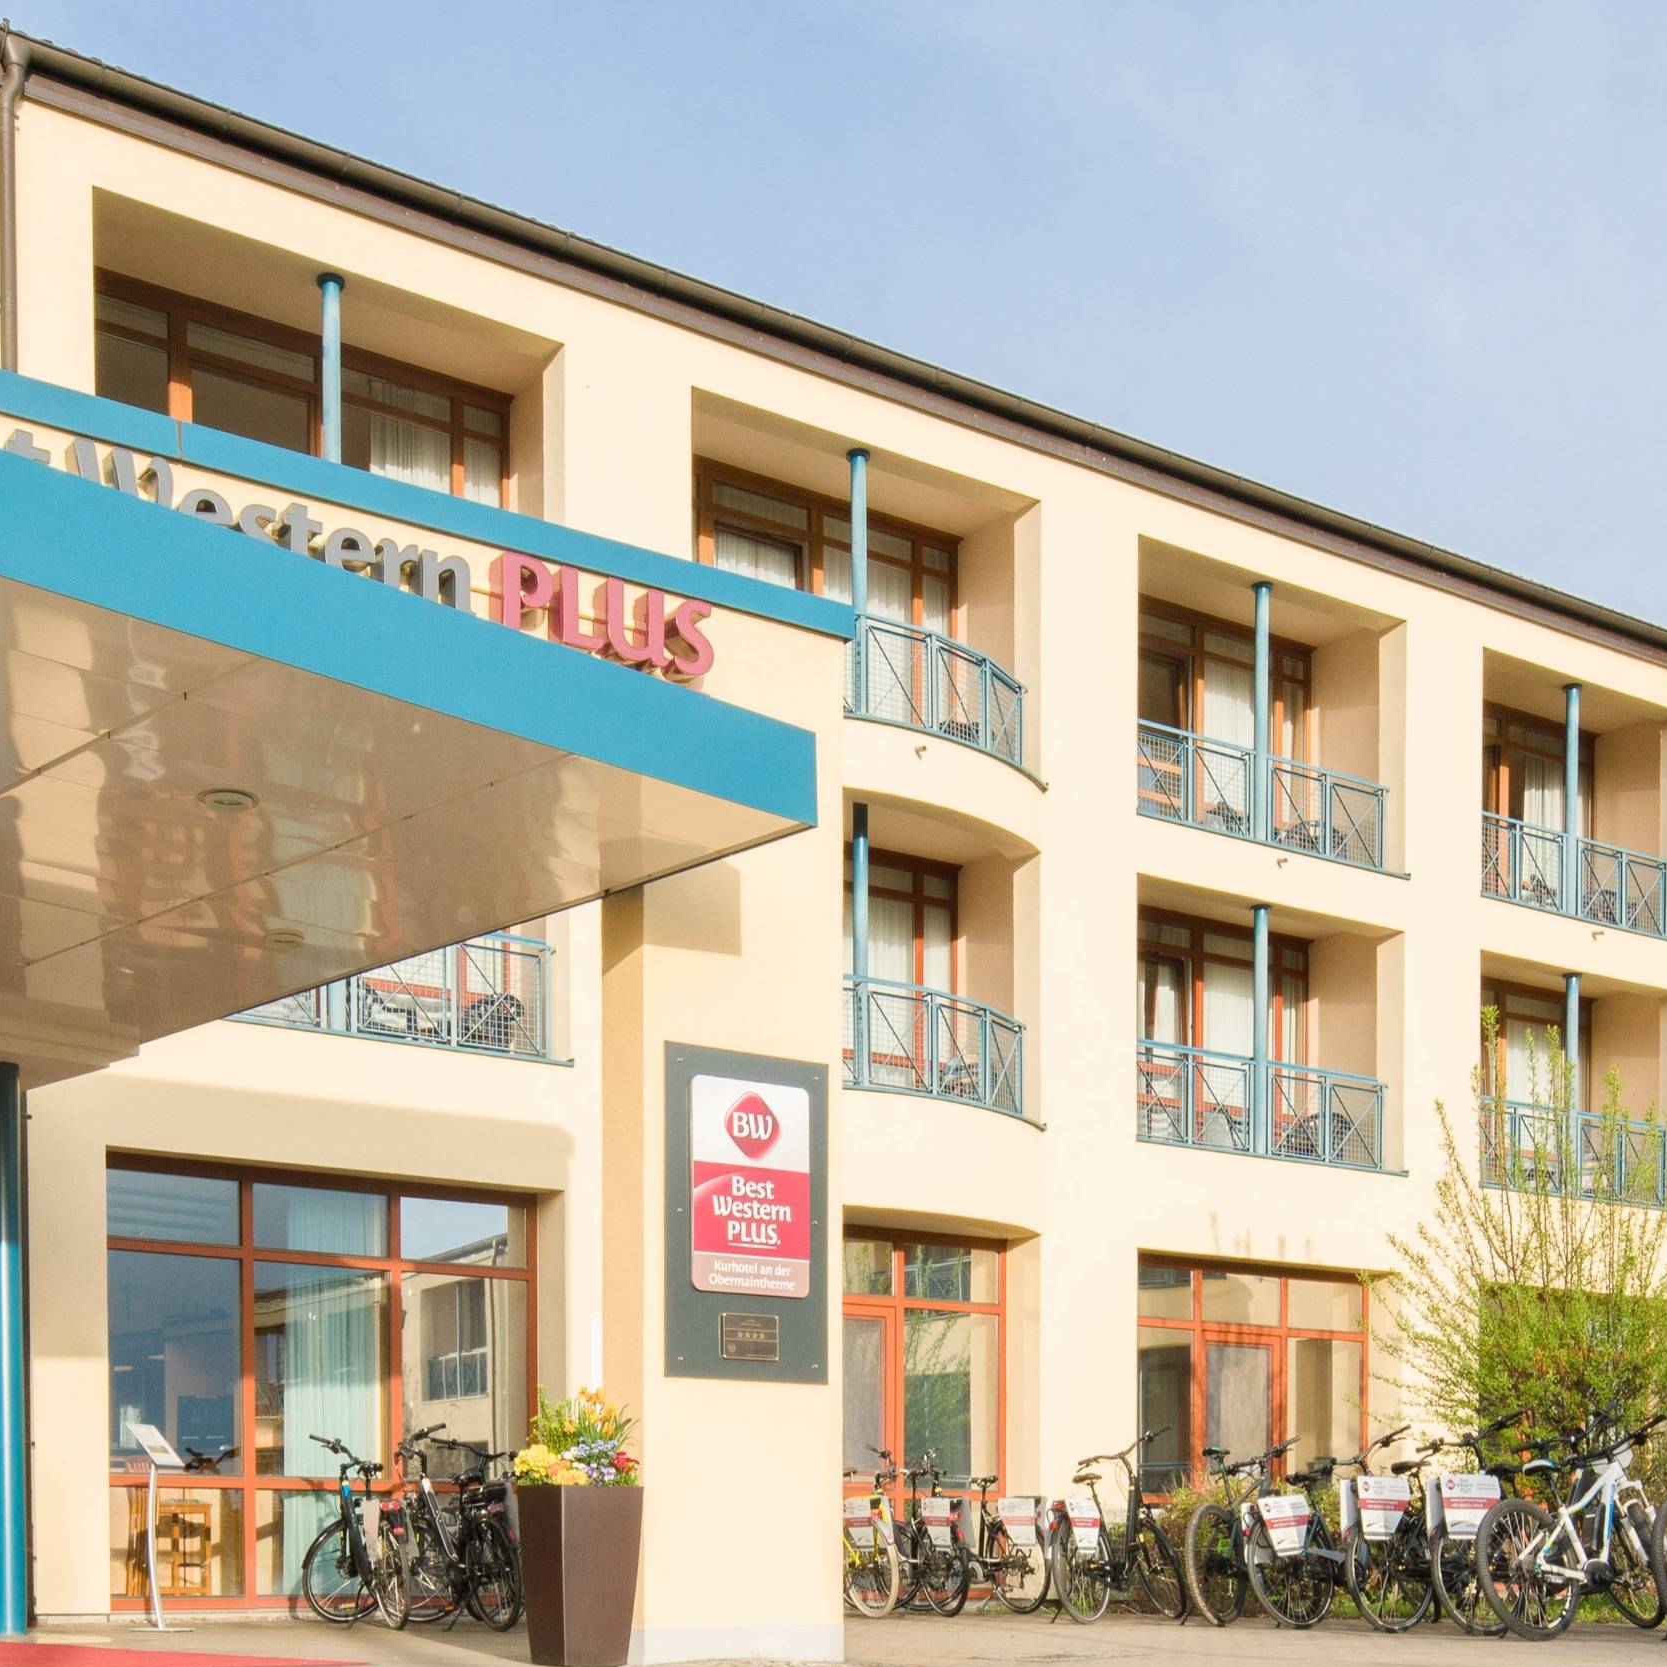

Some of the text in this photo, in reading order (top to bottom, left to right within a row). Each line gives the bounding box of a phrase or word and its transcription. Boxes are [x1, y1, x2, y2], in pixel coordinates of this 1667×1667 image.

[490, 551, 715, 682] PLUS
[732, 1111, 773, 1141] BW
[731, 1174, 775, 1201] Best
[712, 1194, 792, 1223] Western
[713, 1259, 792, 1277] Kurhotel an der
[708, 1274, 797, 1291] Obermaintherme
